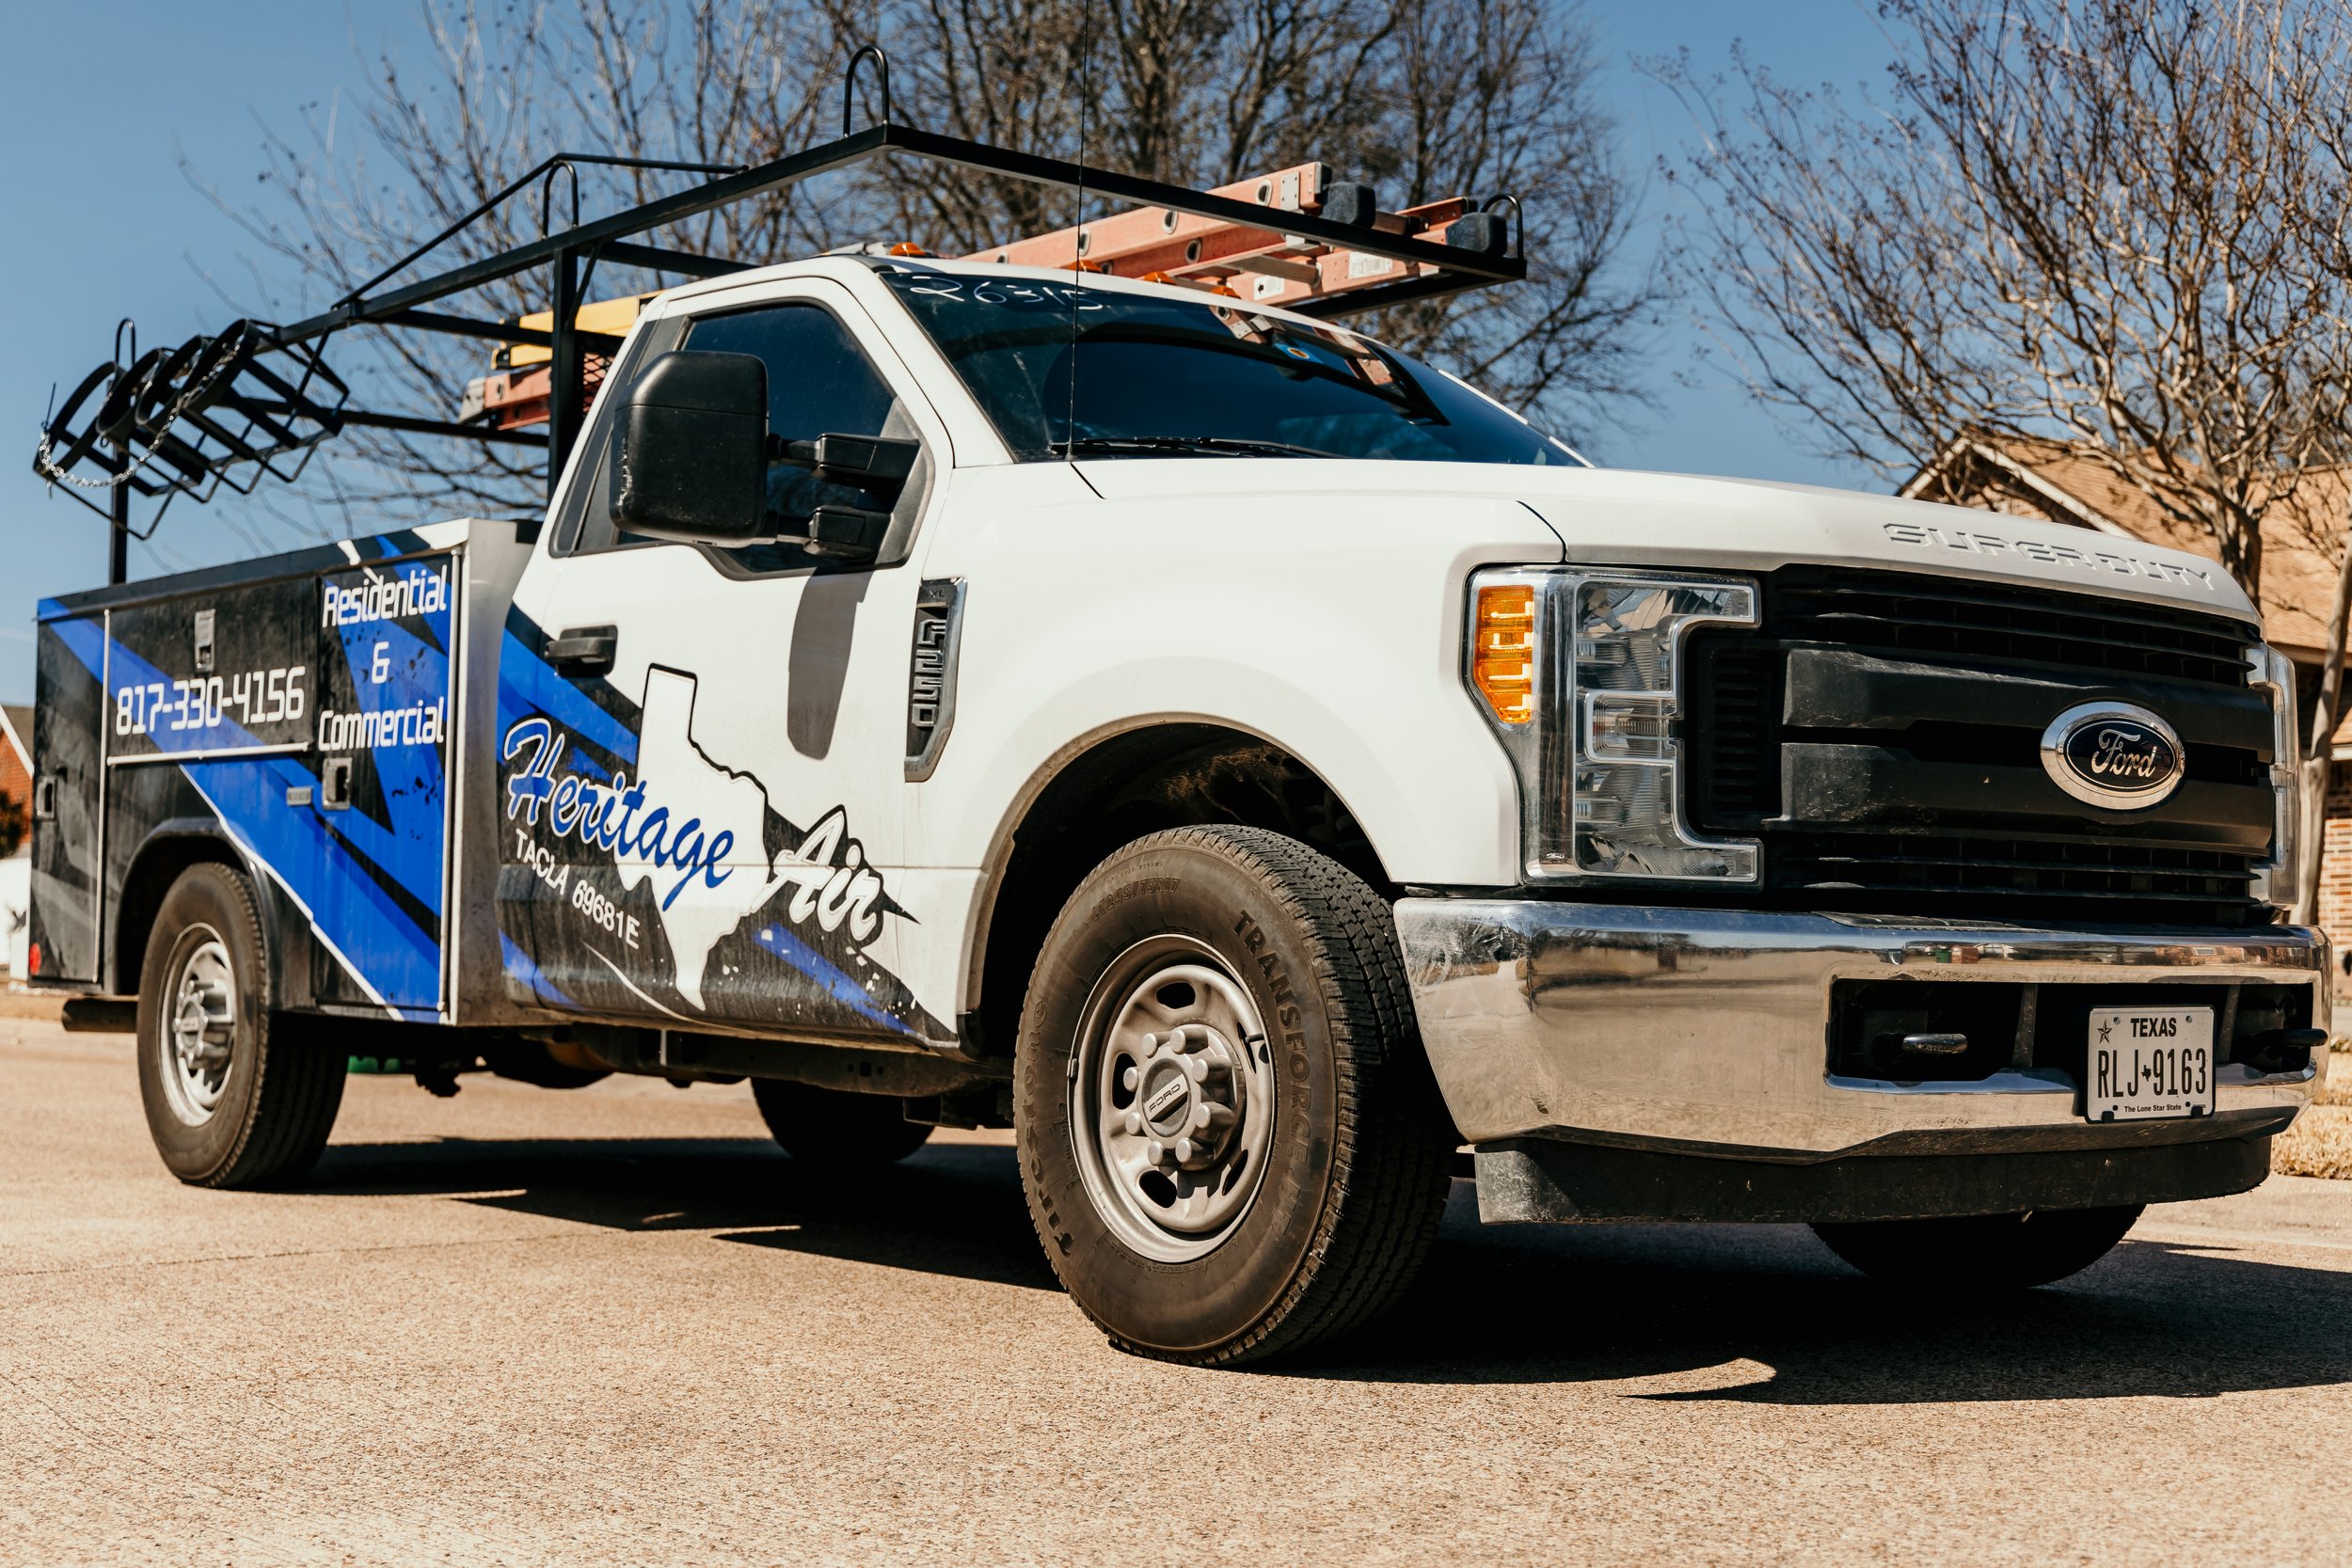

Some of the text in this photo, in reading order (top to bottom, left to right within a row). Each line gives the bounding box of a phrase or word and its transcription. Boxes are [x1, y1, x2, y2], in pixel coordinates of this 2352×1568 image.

[1883, 522, 2215, 592] SUPER DUTY
[322, 565, 448, 628] Residential
[371, 641, 390, 685] &
[116, 666, 306, 736] 817-330-4156
[318, 696, 444, 752] Commercial
[2090, 729, 2156, 778] Ford
[503, 717, 882, 942] Heritage Air
[515, 828, 641, 950] TACLA 69681E
[1232, 908, 1312, 1166] TRANSFORCE
[2130, 1017, 2177, 1037] TEXAS
[1148, 1083, 1181, 1113] FORD
[2097, 1048, 2206, 1099] RLJ 9163
[1024, 996, 1075, 1259] Firestone
